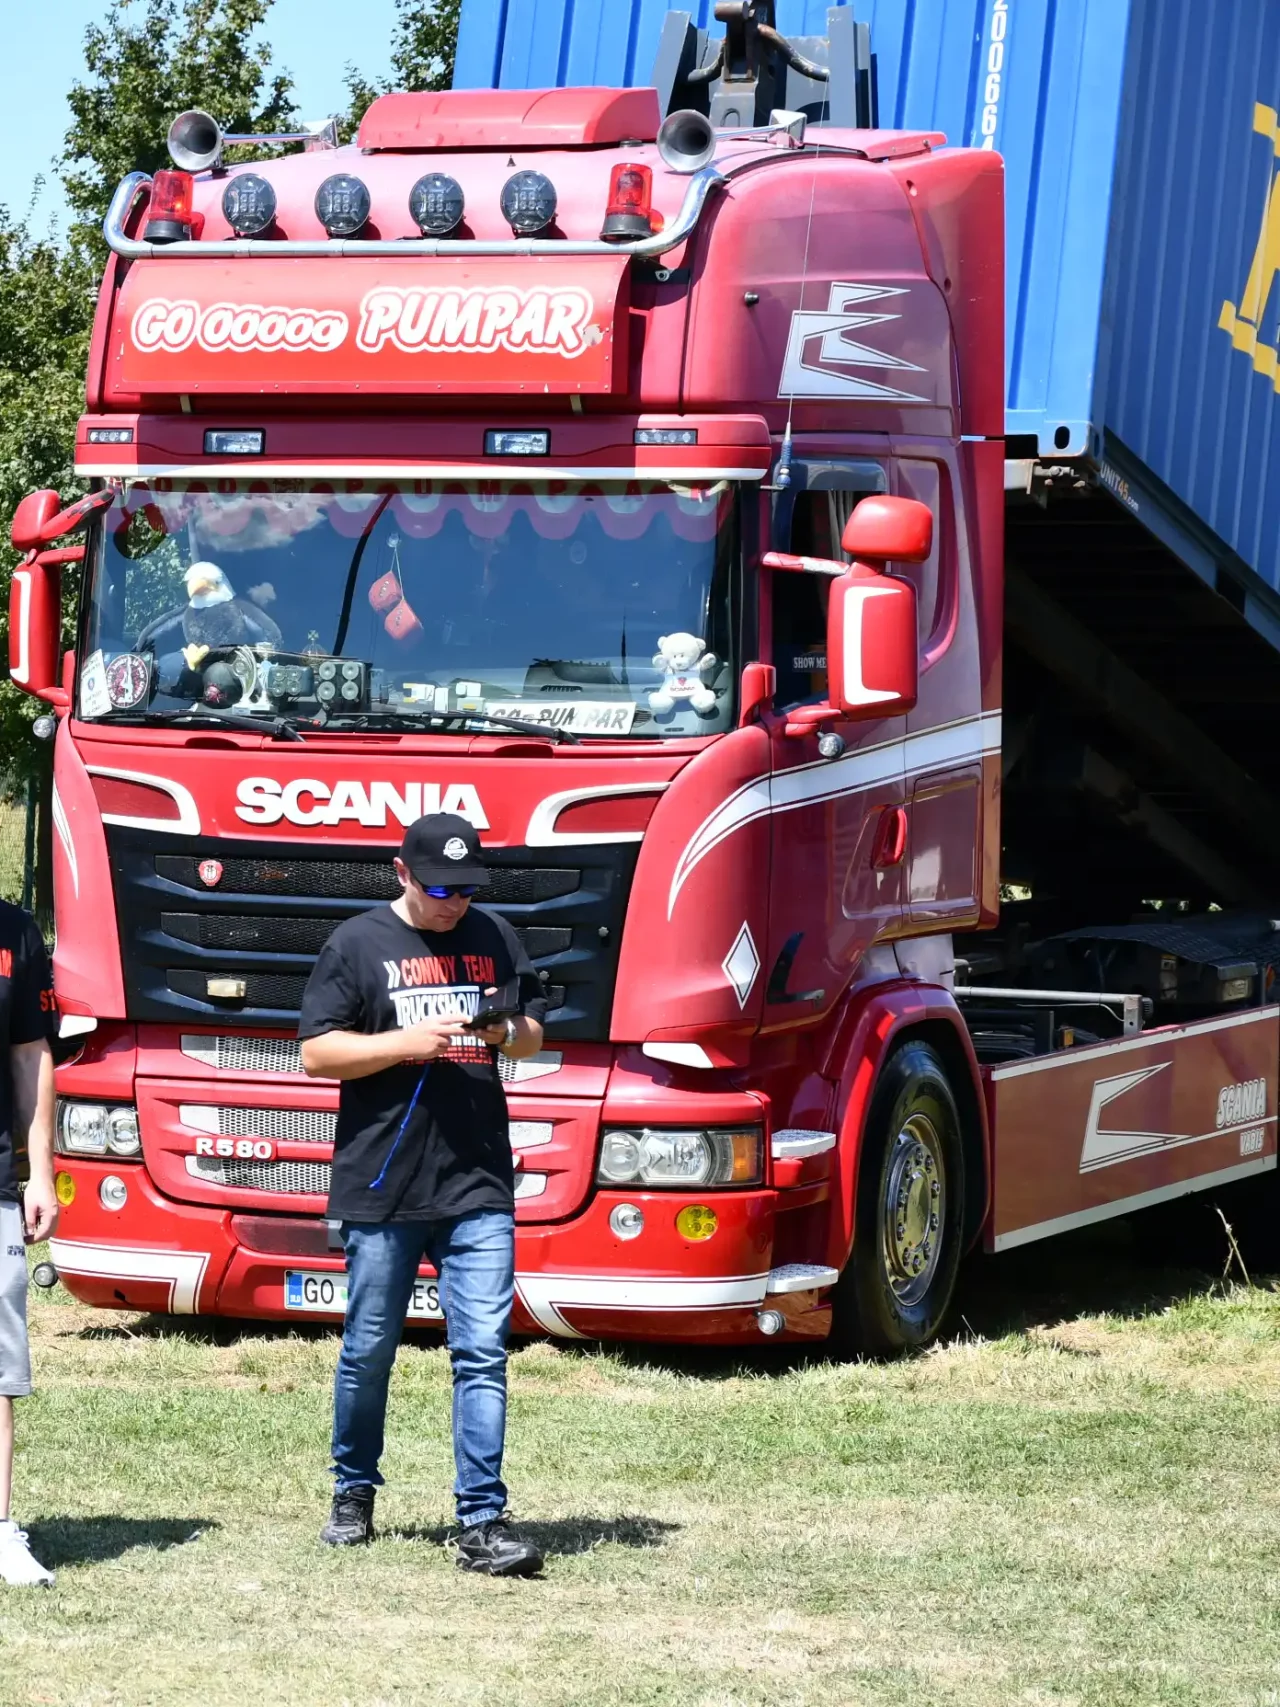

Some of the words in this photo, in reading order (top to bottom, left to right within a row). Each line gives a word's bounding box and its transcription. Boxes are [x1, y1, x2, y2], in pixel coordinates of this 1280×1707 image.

[981, 0, 1009, 150] 0066
[131, 298, 199, 352] GO
[356, 285, 593, 358] PUMPAR
[234, 777, 491, 830] SCANIA
[401, 955, 457, 987] CONVOY
[461, 954, 496, 984] TEAM
[1216, 1078, 1266, 1128] SCANIA
[196, 1137, 272, 1159] R580
[304, 1277, 335, 1304] GO
[408, 1284, 439, 1312] ES
